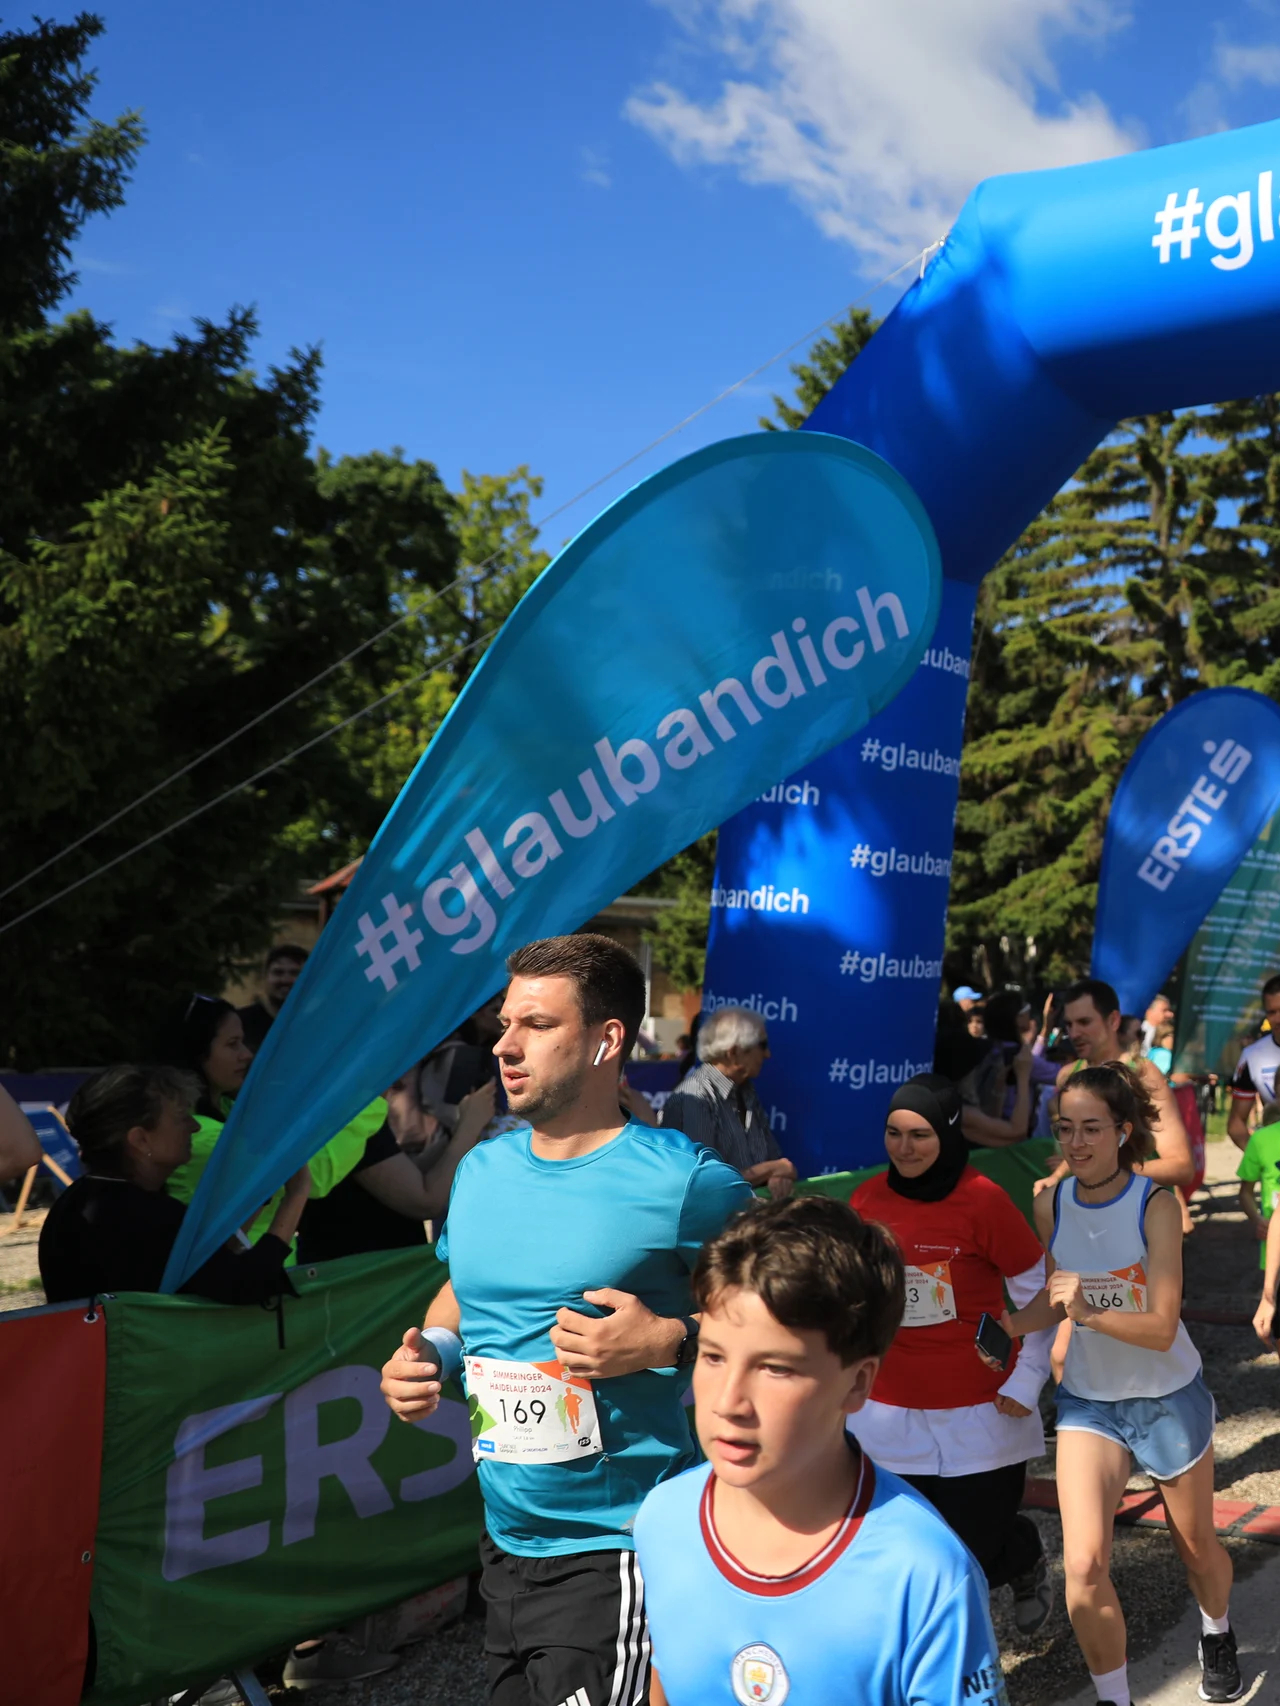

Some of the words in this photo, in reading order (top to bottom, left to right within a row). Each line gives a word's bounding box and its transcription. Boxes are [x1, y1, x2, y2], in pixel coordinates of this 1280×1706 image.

[354, 585, 911, 993] #glaubandich
[1136, 774, 1229, 892] ERSTE
[1088, 1292, 1123, 1308] 166
[492, 1370, 544, 1381] SIMMERINGER
[489, 1382, 528, 1393] HAIDELAUF
[530, 1384, 552, 1393] 2024
[499, 1398, 547, 1425] 169
